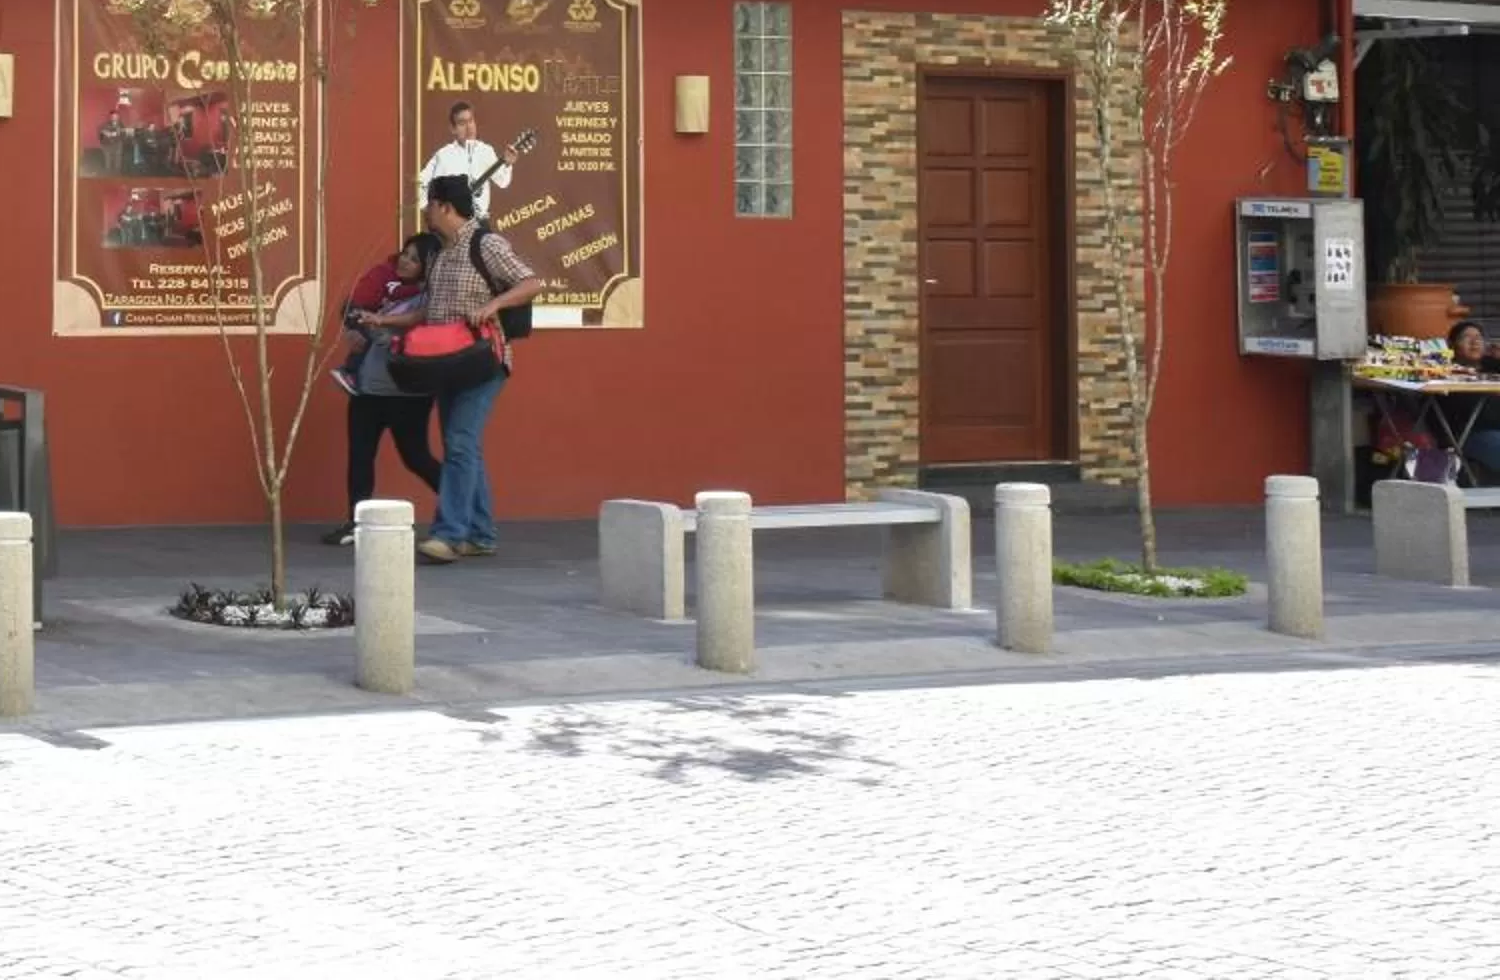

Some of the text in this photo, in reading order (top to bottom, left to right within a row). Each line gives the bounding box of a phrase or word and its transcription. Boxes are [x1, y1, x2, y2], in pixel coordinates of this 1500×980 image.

[94, 52, 170, 80] GRUPO
[427, 56, 541, 93] ALFONSO
[563, 101, 610, 113] JUEVES
[497, 195, 557, 231] MÚSICA
[536, 203, 596, 241] BOTANAS
[150, 263, 207, 274] RESERVA
[561, 232, 618, 269] DIVERSIÓN
